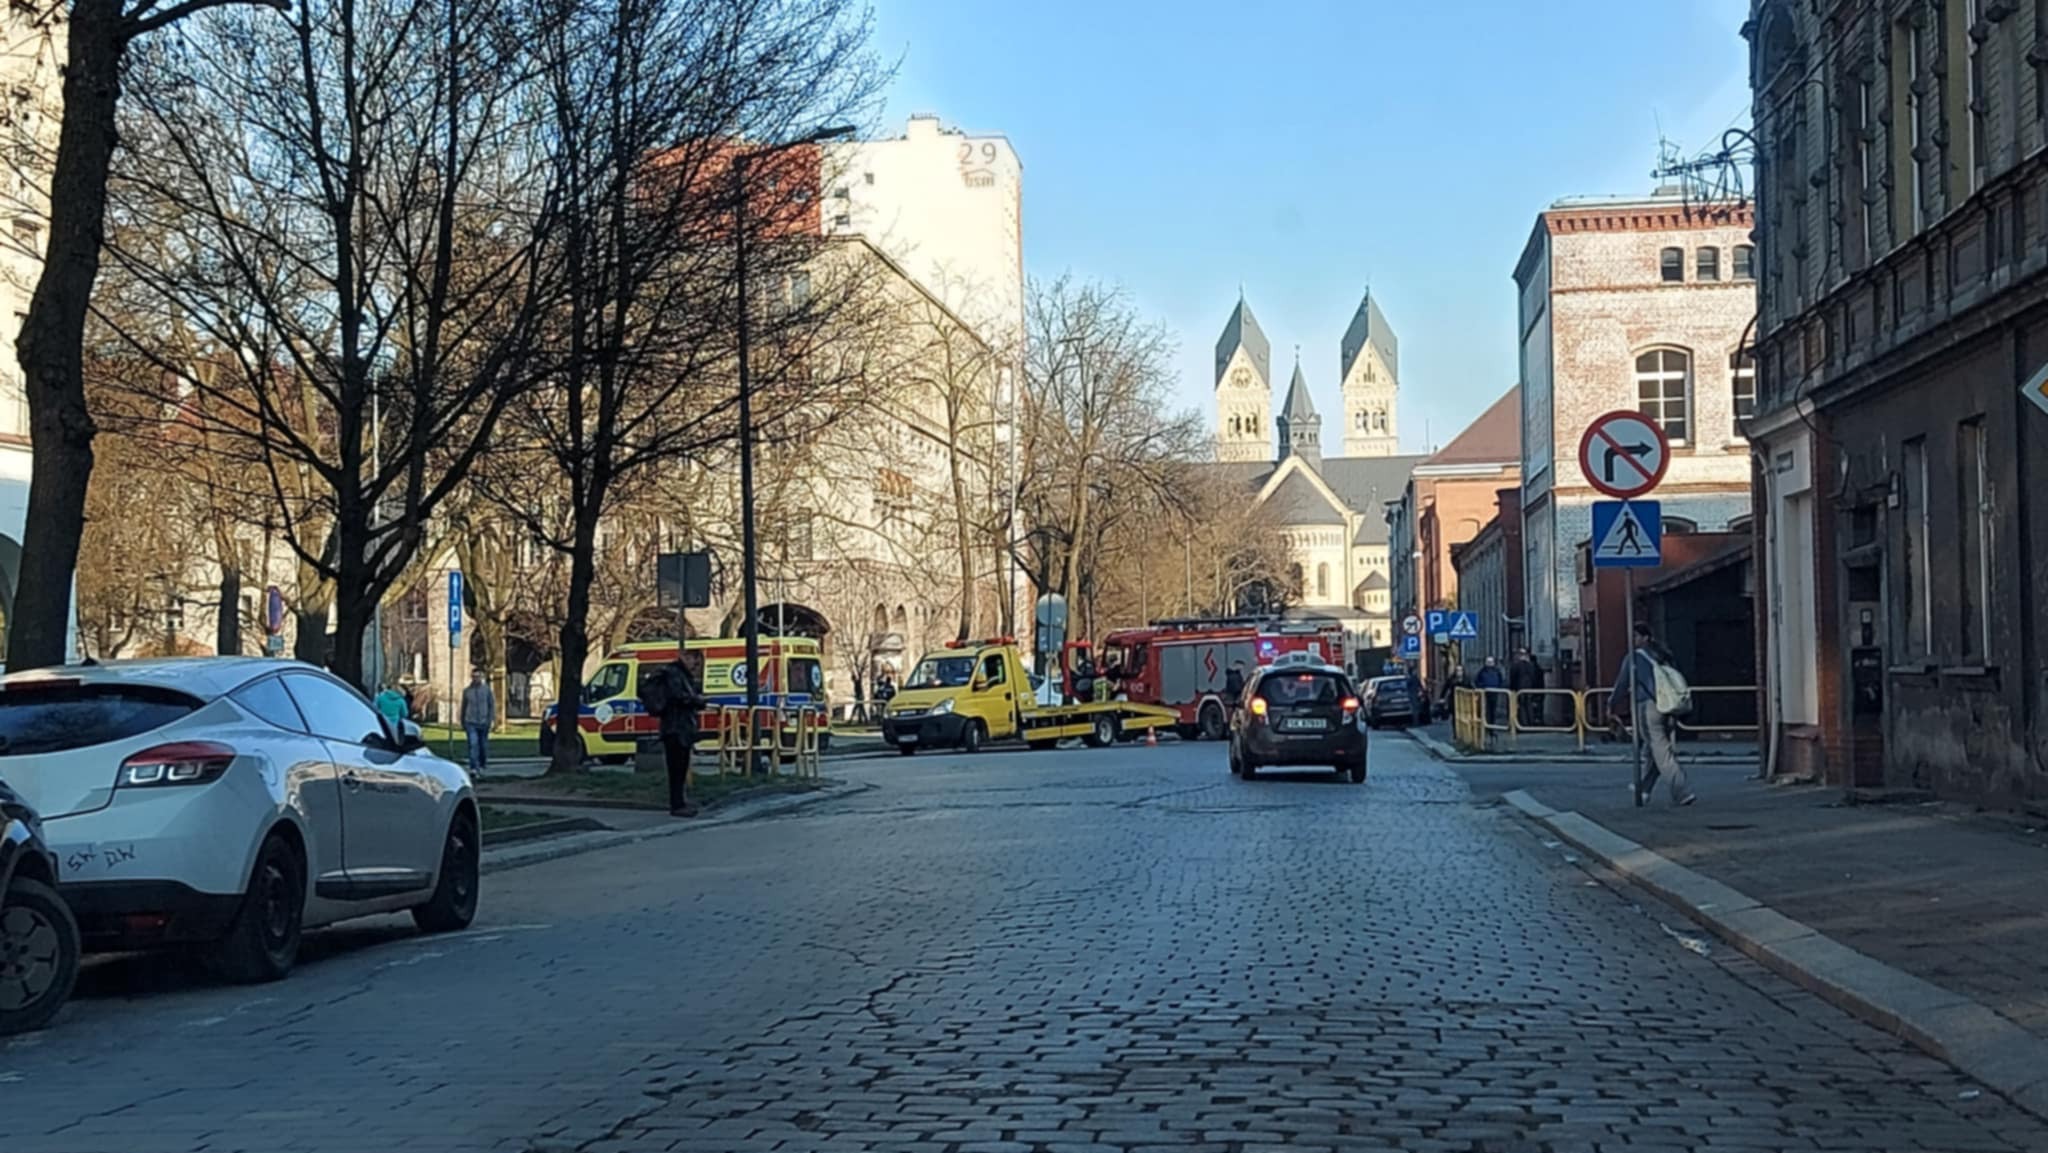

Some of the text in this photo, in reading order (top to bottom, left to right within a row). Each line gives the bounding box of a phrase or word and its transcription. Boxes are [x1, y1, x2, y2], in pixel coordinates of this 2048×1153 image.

[960, 142, 997, 165] 29
[1429, 612, 1443, 631] P
[1407, 636, 1418, 650] P
